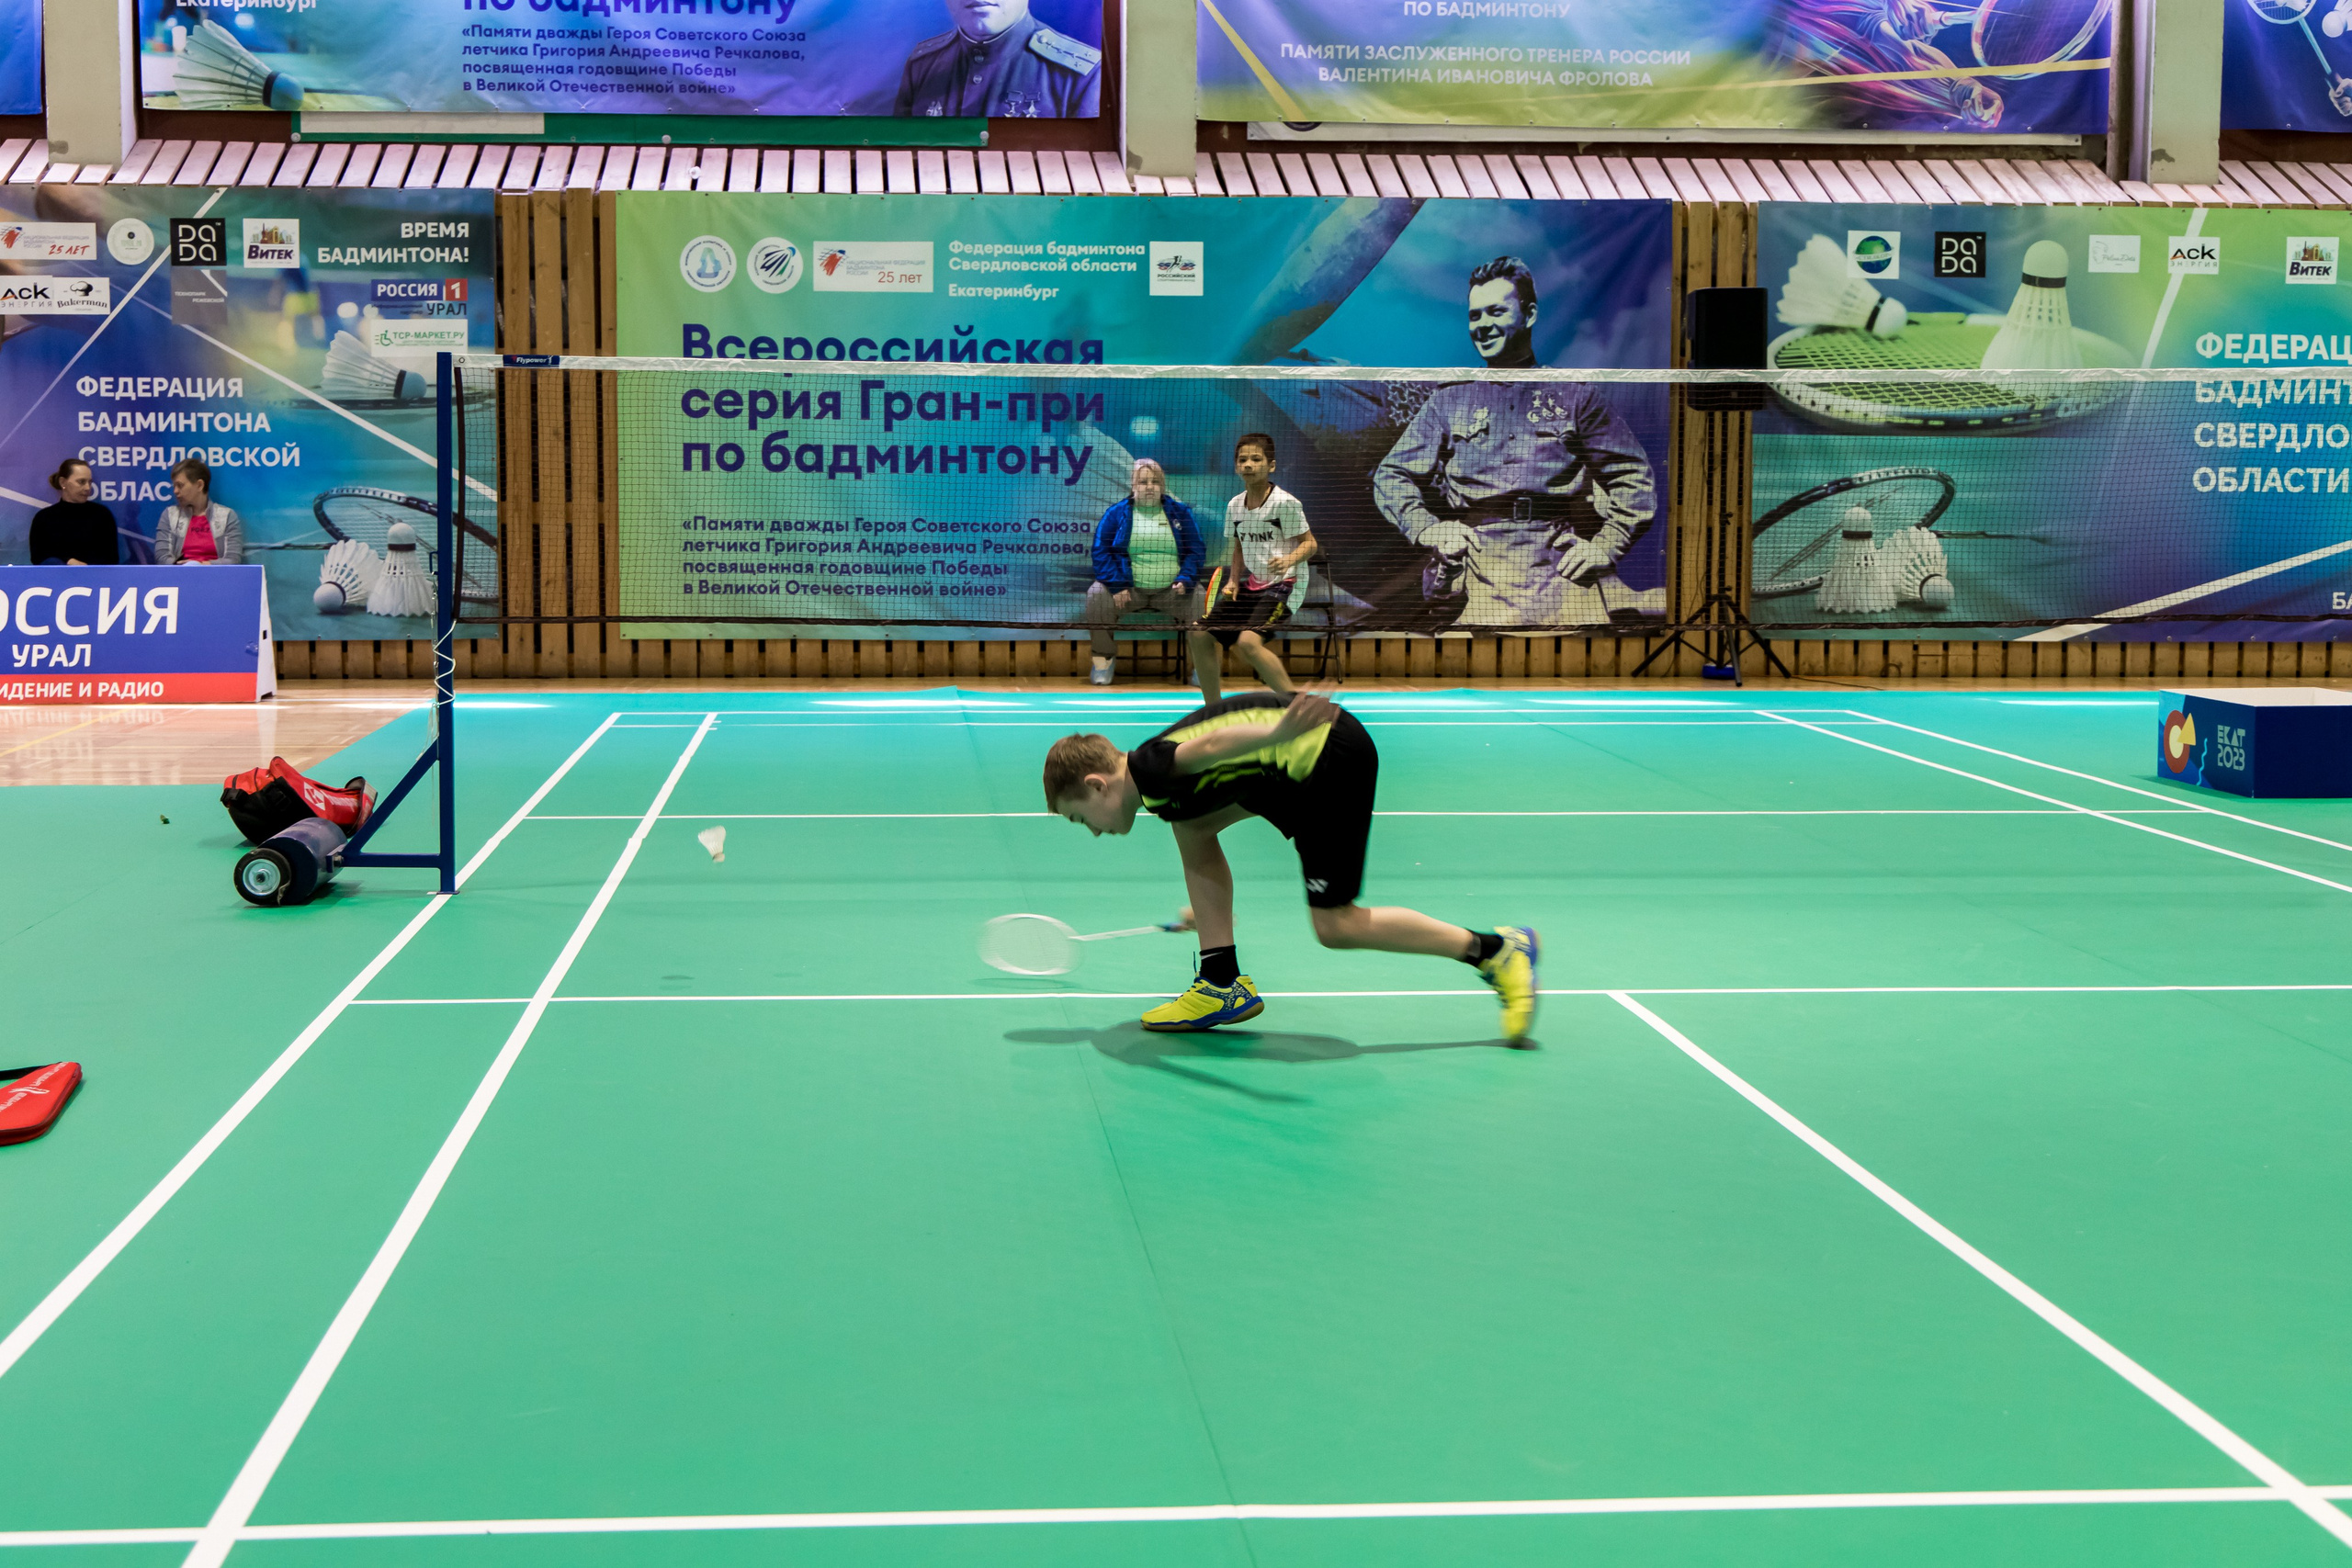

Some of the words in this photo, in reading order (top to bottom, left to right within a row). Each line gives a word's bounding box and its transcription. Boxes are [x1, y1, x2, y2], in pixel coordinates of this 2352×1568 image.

[1403, 1, 1432, 17] ПО
[1436, 1, 1570, 19] БАДМИНТОНУ
[462, 25, 532, 39] «Памяти
[536, 28, 603, 40] дважды
[606, 26, 651, 42] Героя
[655, 28, 749, 42] Советского
[752, 28, 807, 42] Союза
[462, 45, 529, 57] летчика
[532, 43, 606, 61] Григория
[609, 44, 710, 61] Андреевича
[715, 47, 806, 62] Речкалова,
[1281, 43, 1361, 61] ПАМЯТИ
[1364, 45, 1523, 63] ЗАСЛУЖЕННОГО
[1527, 48, 1606, 64] ТРЕНЕРА
[1610, 49, 1691, 66] РОССИИ
[462, 62, 574, 77] посвященная
[579, 64, 668, 78] годовщине
[673, 63, 737, 79] Победы
[1318, 67, 1433, 84] ВАЛЕНТИНА
[1437, 68, 1556, 86] ИВАНОВИЧА
[1559, 70, 1654, 87] ФРОЛОВА
[463, 81, 472, 91] в
[476, 79, 546, 92] Великой
[549, 80, 674, 94] Отечественной
[679, 81, 736, 95] войне»
[401, 222, 469, 238] ВРЕМЯ
[49, 244, 62, 255] 25
[65, 244, 90, 255] ЛЕТ
[318, 247, 469, 265] БАДМИНТОНА!
[948, 241, 1043, 257] Федерация
[1046, 242, 1146, 256] бадминтона
[948, 257, 1068, 274] Свердловской
[1071, 259, 1137, 272] области
[877, 271, 895, 283] 25
[899, 274, 922, 284] лет
[377, 283, 438, 297] РОССИЯ
[451, 282, 461, 299] 1
[948, 284, 1059, 301] Екатеринбург
[57, 299, 107, 309] Bakerman
[427, 303, 467, 315] УРАЛ
[683, 323, 1103, 375] Всероссийская
[2195, 332, 2352, 365] ФЕДЕРАЦ
[76, 376, 243, 400] ФЕДЕРАЦИЯ
[681, 387, 842, 431] серия
[860, 380, 1103, 433] Гран-при
[78, 412, 272, 435] БАДМИНТОНА
[2194, 422, 2350, 453] СВЕРДЛО
[78, 442, 300, 470] СВЕРДЛОВСКОЙ
[683, 441, 746, 473] по
[762, 430, 1094, 487] бадминтону
[2192, 467, 2350, 494] ОБЛАСТИ
[682, 515, 765, 533] «Памяти
[770, 518, 850, 535] дважды
[854, 517, 907, 536] Героя
[911, 517, 1023, 535] Советского
[1027, 518, 1091, 535] Союза
[682, 539, 761, 553] летчика
[765, 537, 853, 558] Григория
[856, 539, 978, 558] Андреевича
[982, 539, 1091, 558] Речкалова,
[683, 560, 815, 577] посвященная
[820, 561, 927, 578] годовщине
[932, 560, 1009, 579] Победы
[684, 584, 694, 595] в
[699, 580, 780, 595] Великой
[785, 581, 934, 597] Отечественной
[939, 581, 1007, 597] войне»
[12, 644, 92, 668] УРАЛ
[79, 682, 92, 697] И
[98, 682, 164, 699] РАДИО
[2217, 746, 2246, 771] 2023
